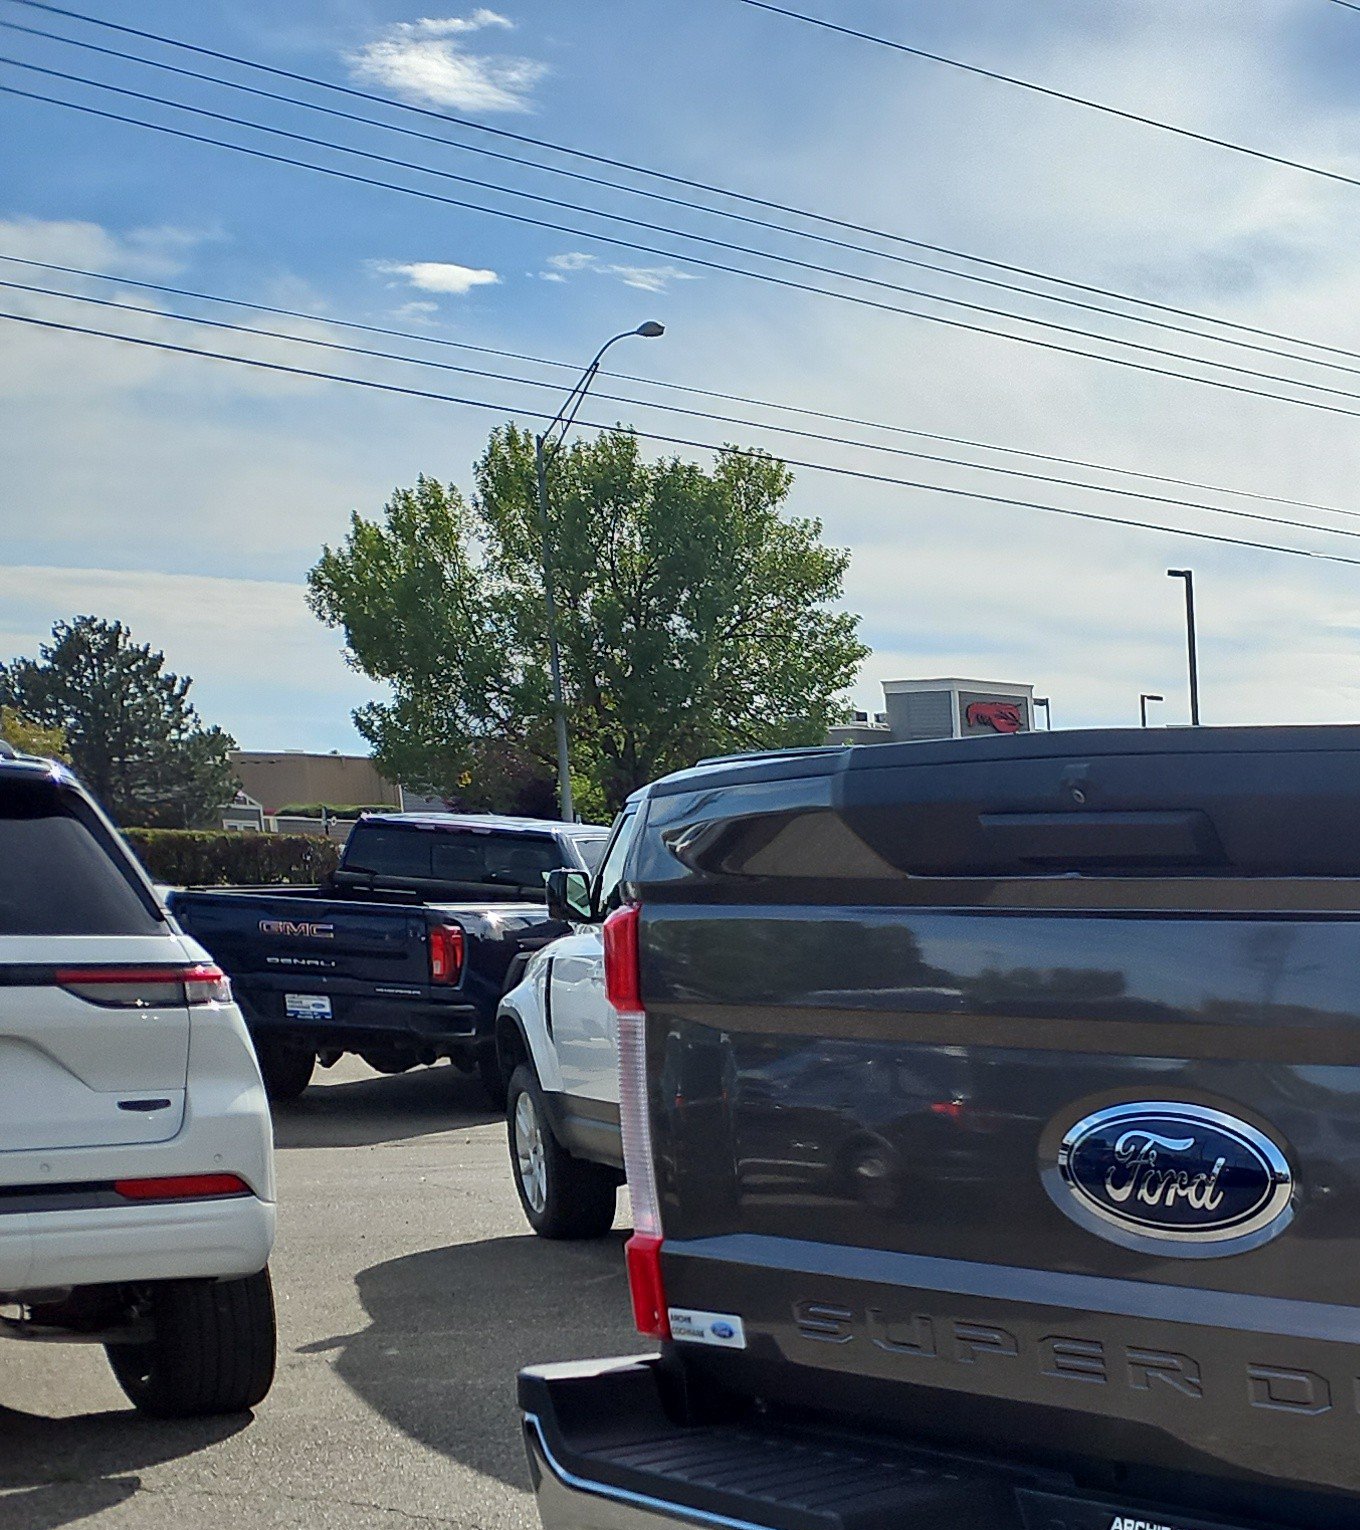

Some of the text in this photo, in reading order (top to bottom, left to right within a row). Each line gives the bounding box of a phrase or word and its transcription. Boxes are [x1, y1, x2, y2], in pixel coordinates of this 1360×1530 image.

[259, 920, 334, 939] GMC
[266, 957, 336, 967] DENALI
[1104, 1129, 1227, 1210] Ford
[790, 1299, 1204, 1399] SUPER
